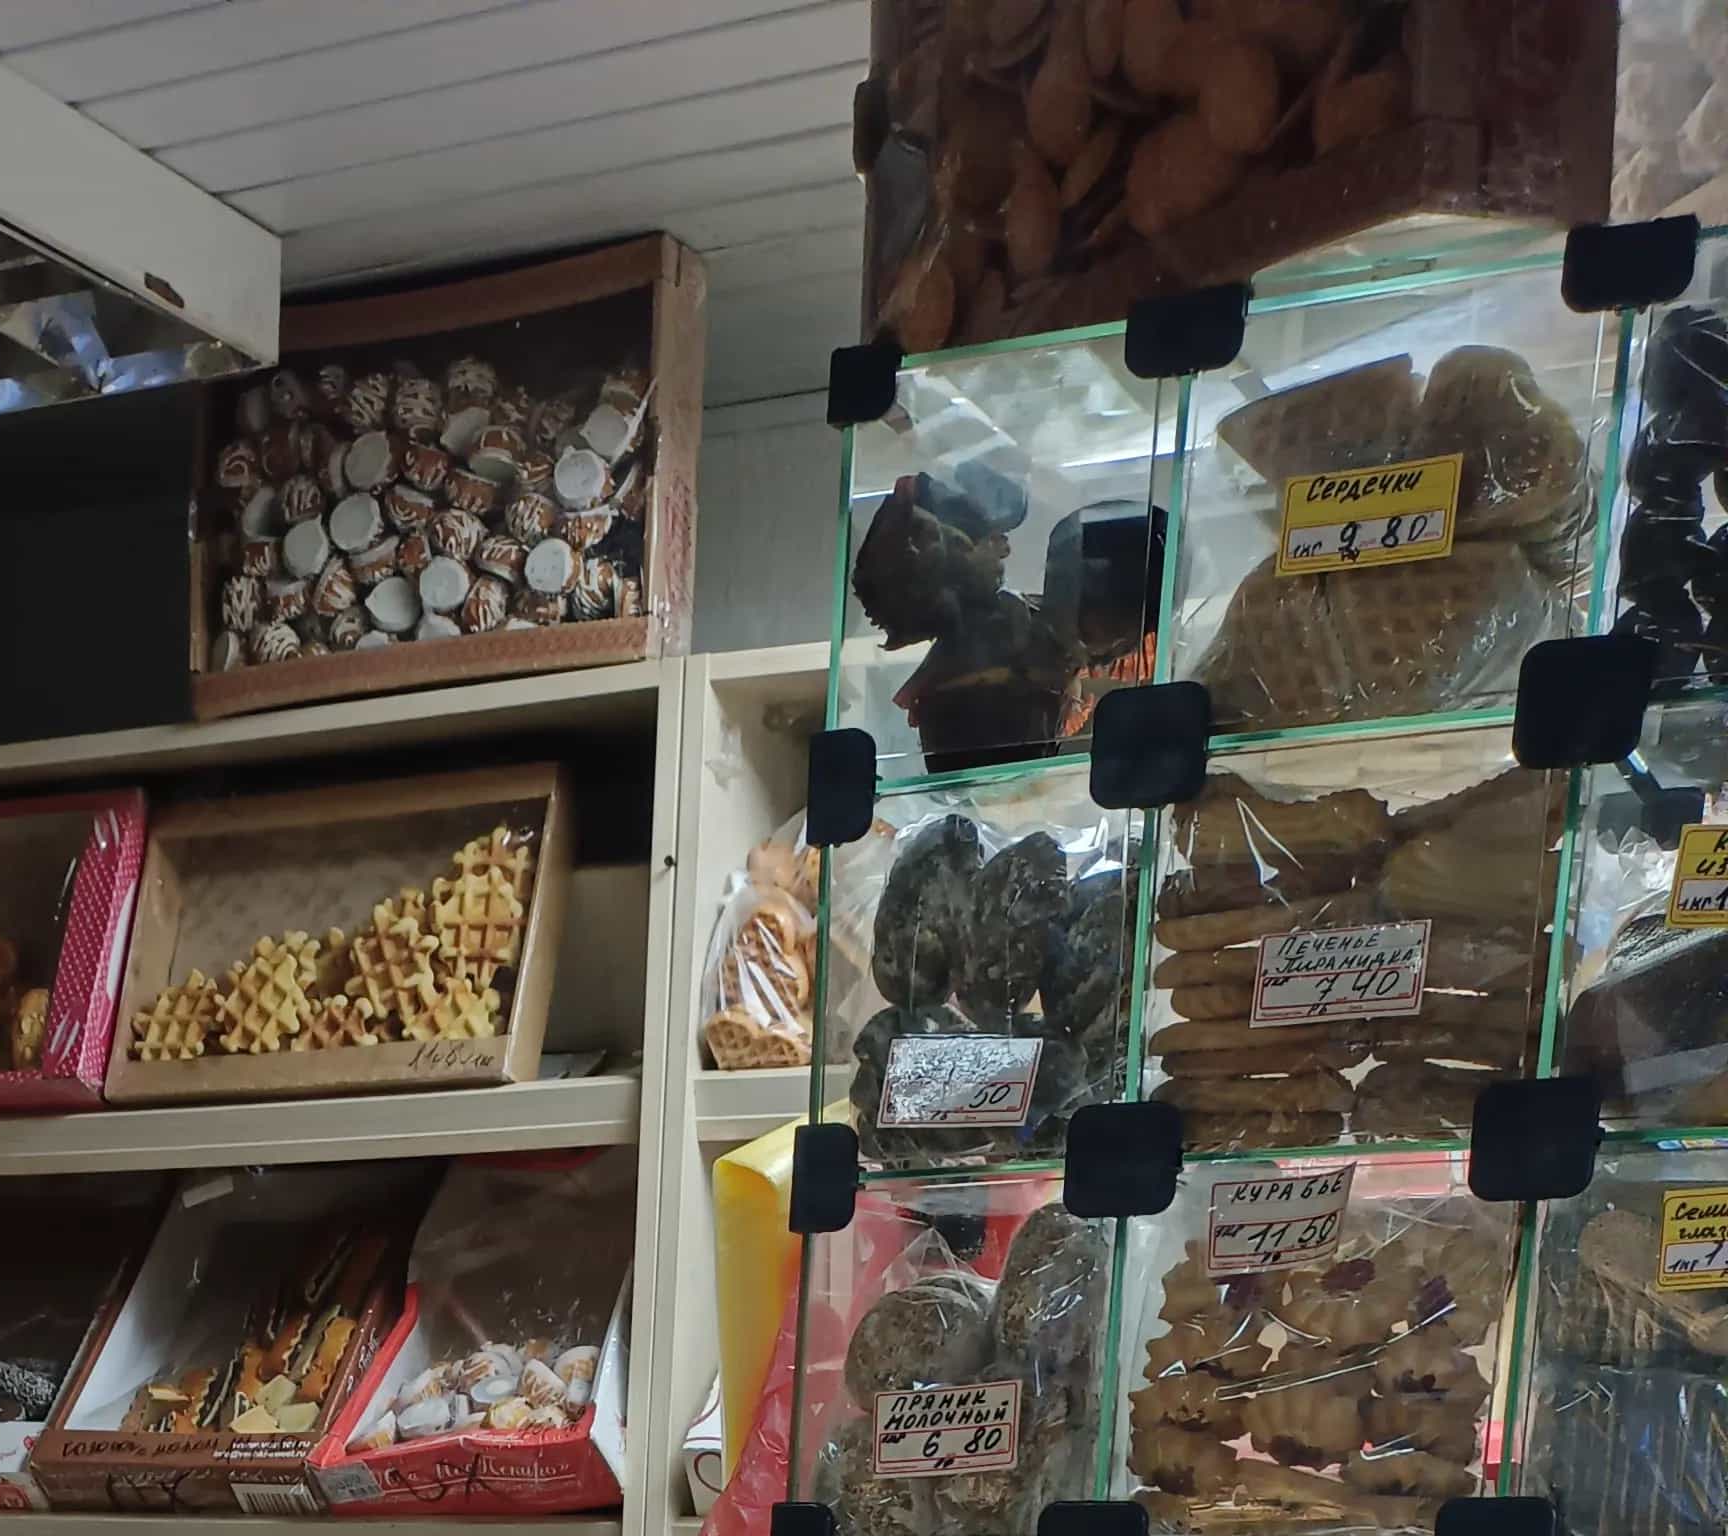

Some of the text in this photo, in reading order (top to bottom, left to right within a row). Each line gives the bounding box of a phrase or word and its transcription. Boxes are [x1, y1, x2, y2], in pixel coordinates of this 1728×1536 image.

[1307, 470, 1422, 503] Сердечки
[1278, 933, 1379, 957] ПЕЧЕНЬЕ
[1231, 1173, 1345, 1204] КУРАБЬЕ
[891, 1389, 988, 1412] ПРЯНИК
[884, 1401, 1009, 1430] МОЛОЧНЫЙ
